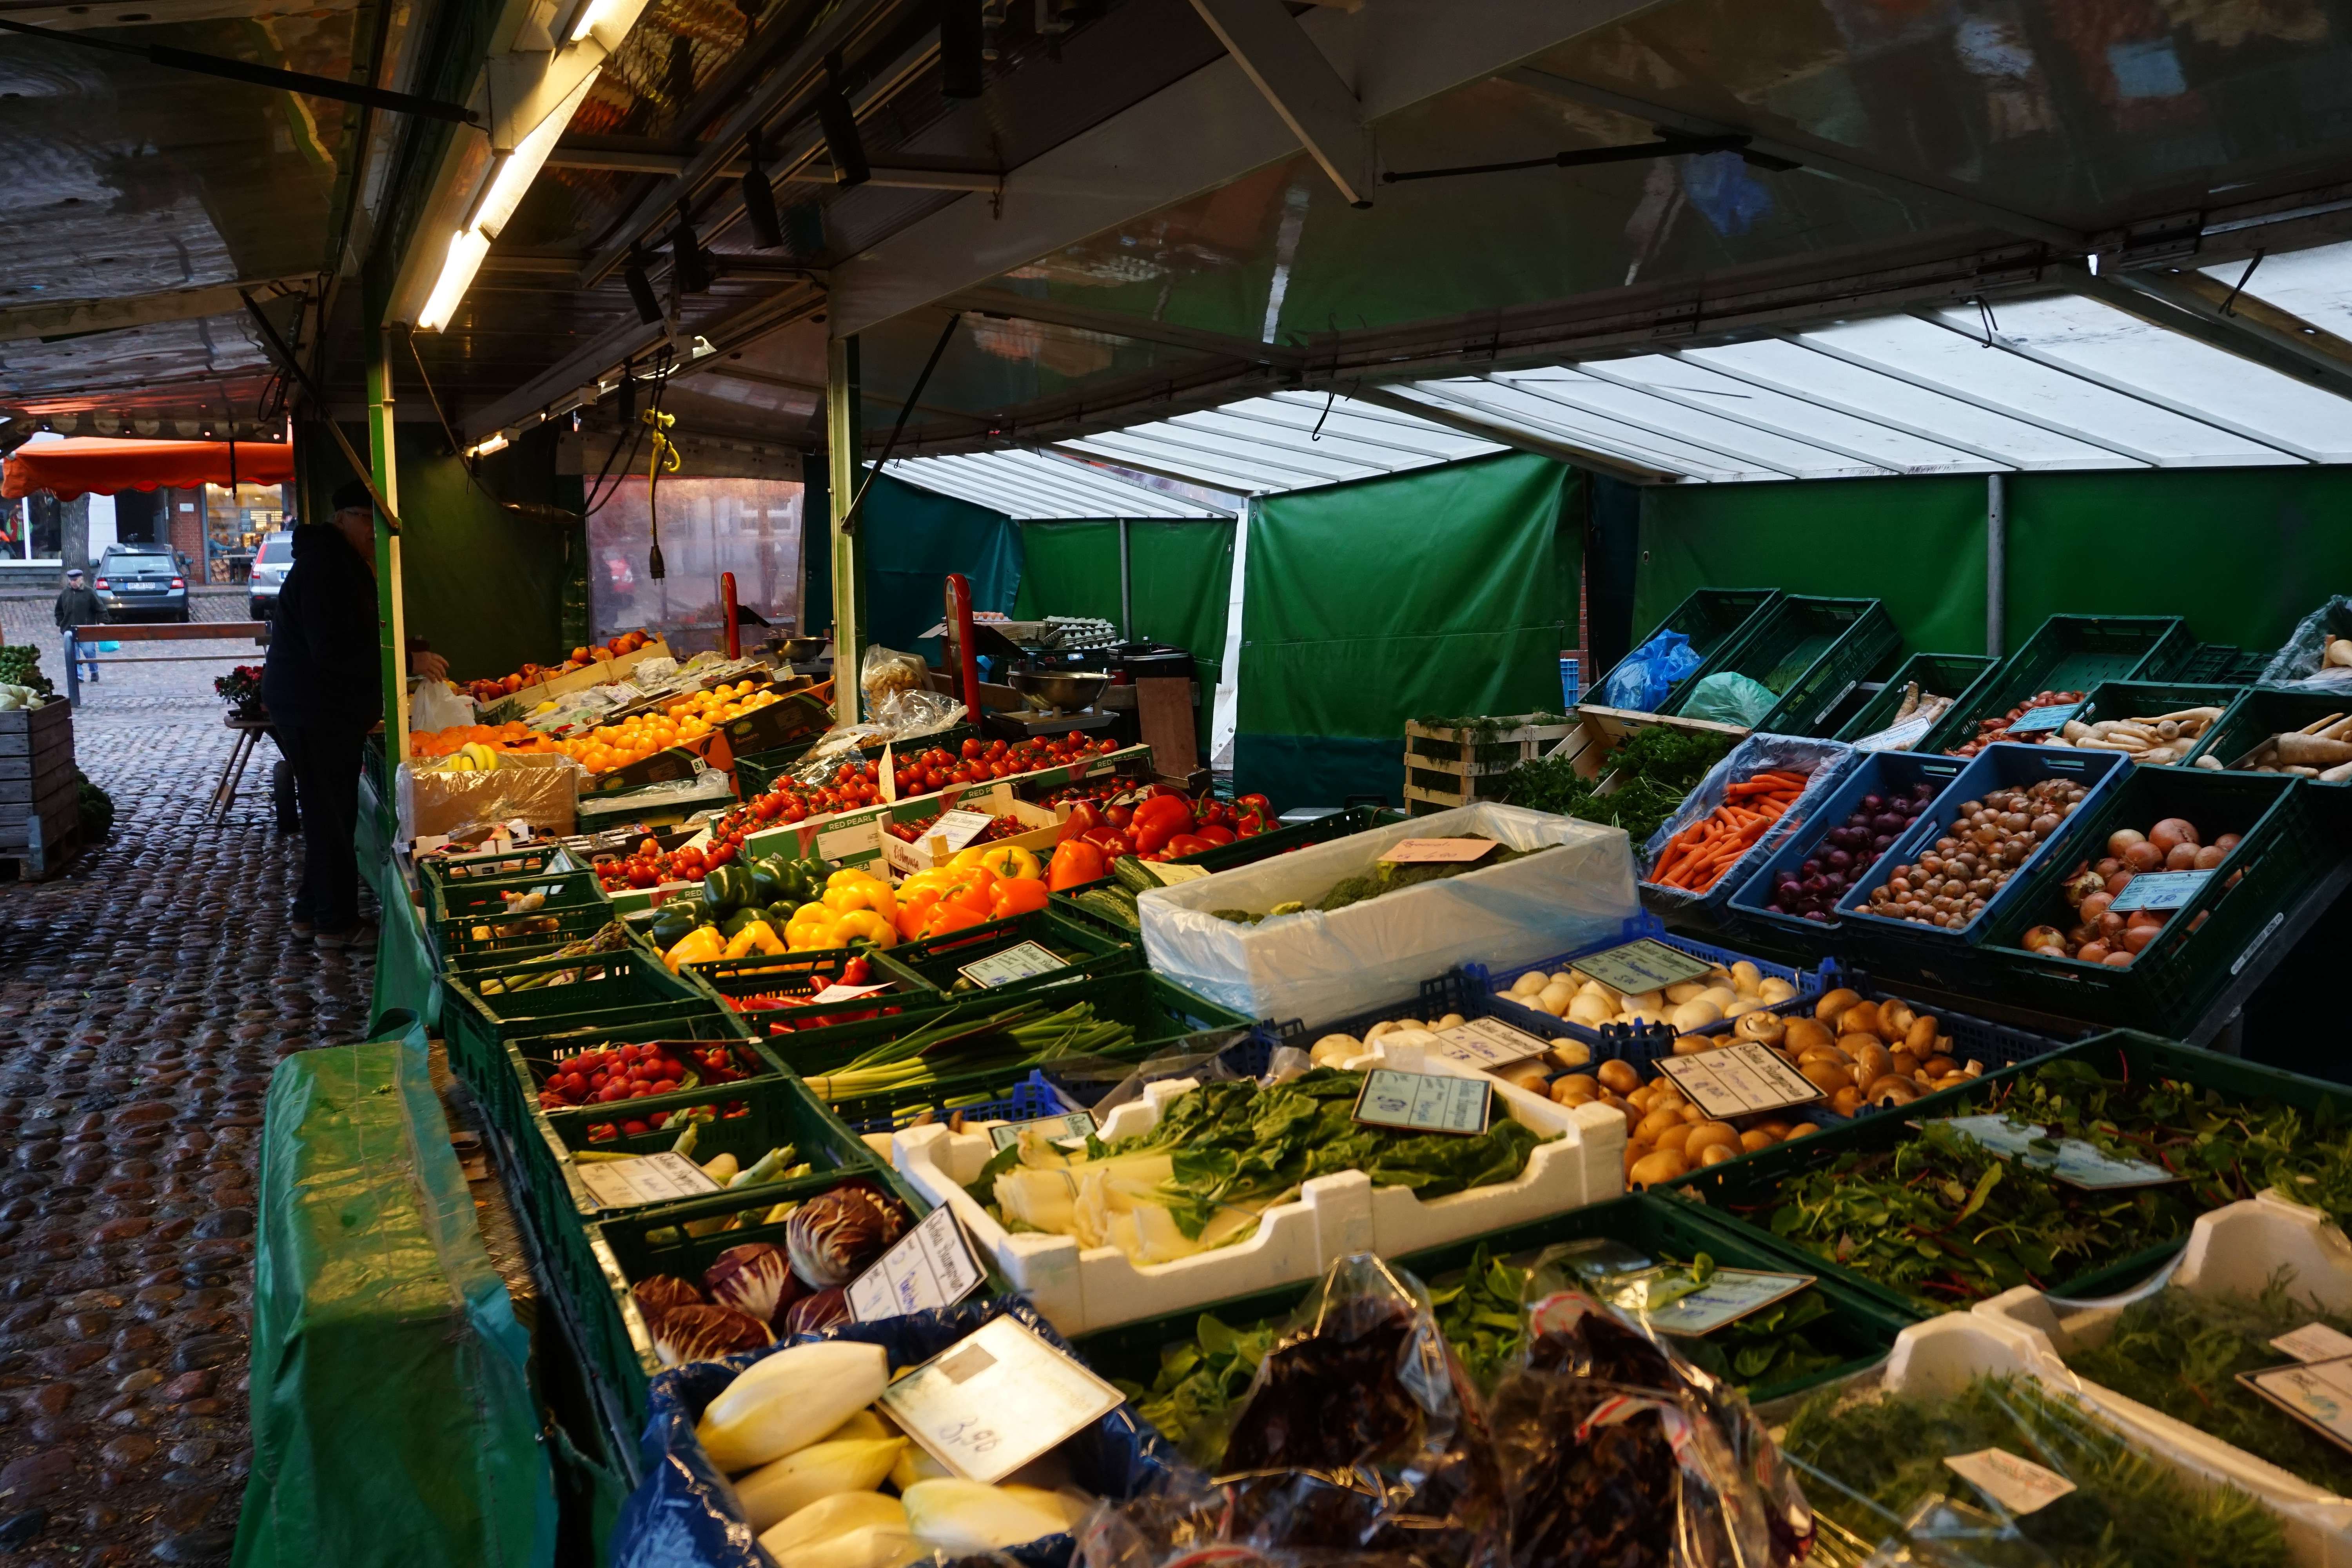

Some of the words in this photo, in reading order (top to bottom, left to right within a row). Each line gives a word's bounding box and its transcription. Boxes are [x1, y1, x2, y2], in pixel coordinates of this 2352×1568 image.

[1855, 736, 1880, 746] Obstbau
[1882, 720, 1924, 737] Baumgarten
[693, 760, 705, 771] 81
[1097, 759, 1112, 768] RED
[969, 788, 984, 798] RED
[829, 821, 846, 831] RED
[846, 815, 874, 826] PEARL
[684, 889, 703, 898] RED
[1738, 1045, 1764, 1065] Obstbau
[1760, 1063, 1804, 1098] Baumgarten
[925, 1212, 945, 1247] Obstbau
[936, 1237, 965, 1292] Baumgarten
